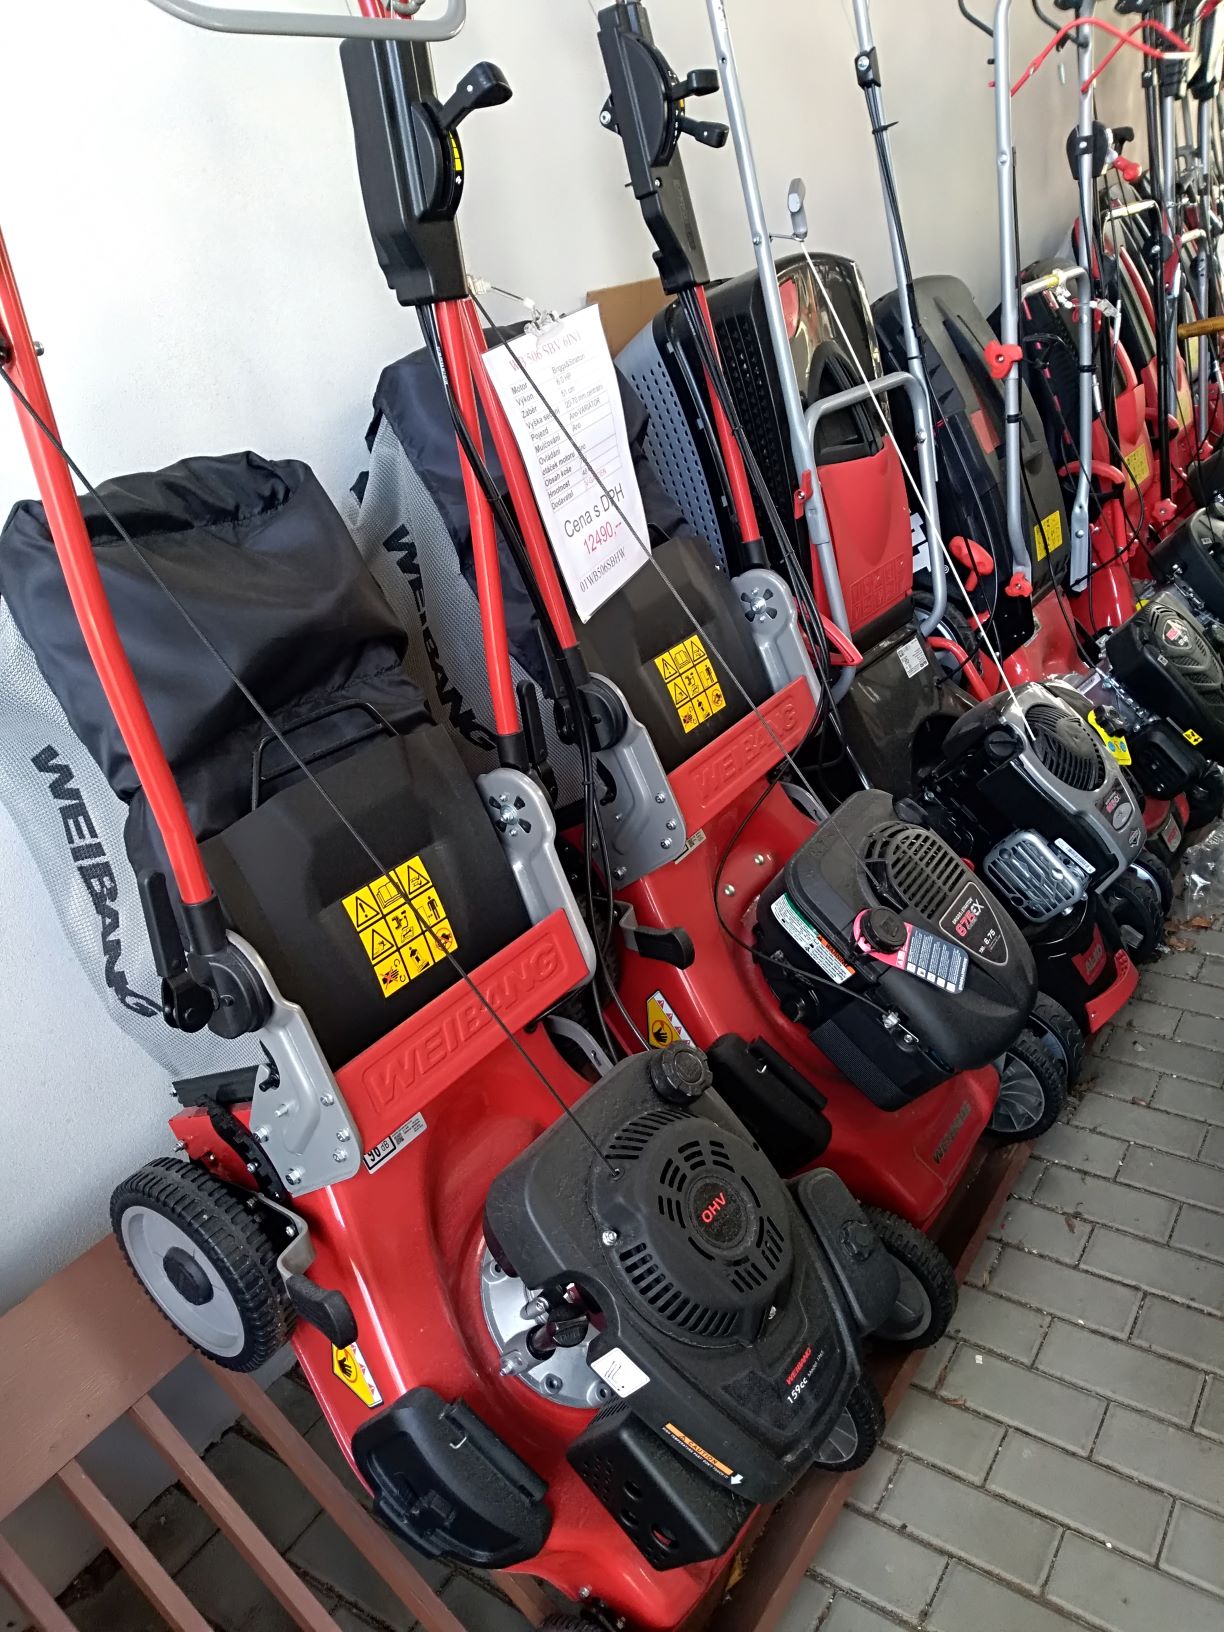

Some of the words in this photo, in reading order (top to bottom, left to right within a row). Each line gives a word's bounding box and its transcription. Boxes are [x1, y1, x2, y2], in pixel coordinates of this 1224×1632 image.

[542, 340, 561, 356] SBV
[511, 382, 528, 396] Motor
[516, 392, 535, 406] Výkon
[530, 426, 549, 442] Pojezd
[564, 510, 593, 538] Cena
[593, 505, 601, 518] s
[600, 482, 625, 512] DPH
[382, 523, 498, 751] WEIBANG
[31, 744, 163, 1017] WEIBANG
[369, 943, 560, 1108] WEIBANG
[702, 1192, 726, 1223] OHV
[787, 1377, 808, 1405] 159cc
[687, 1440, 717, 1464] CAUTION
